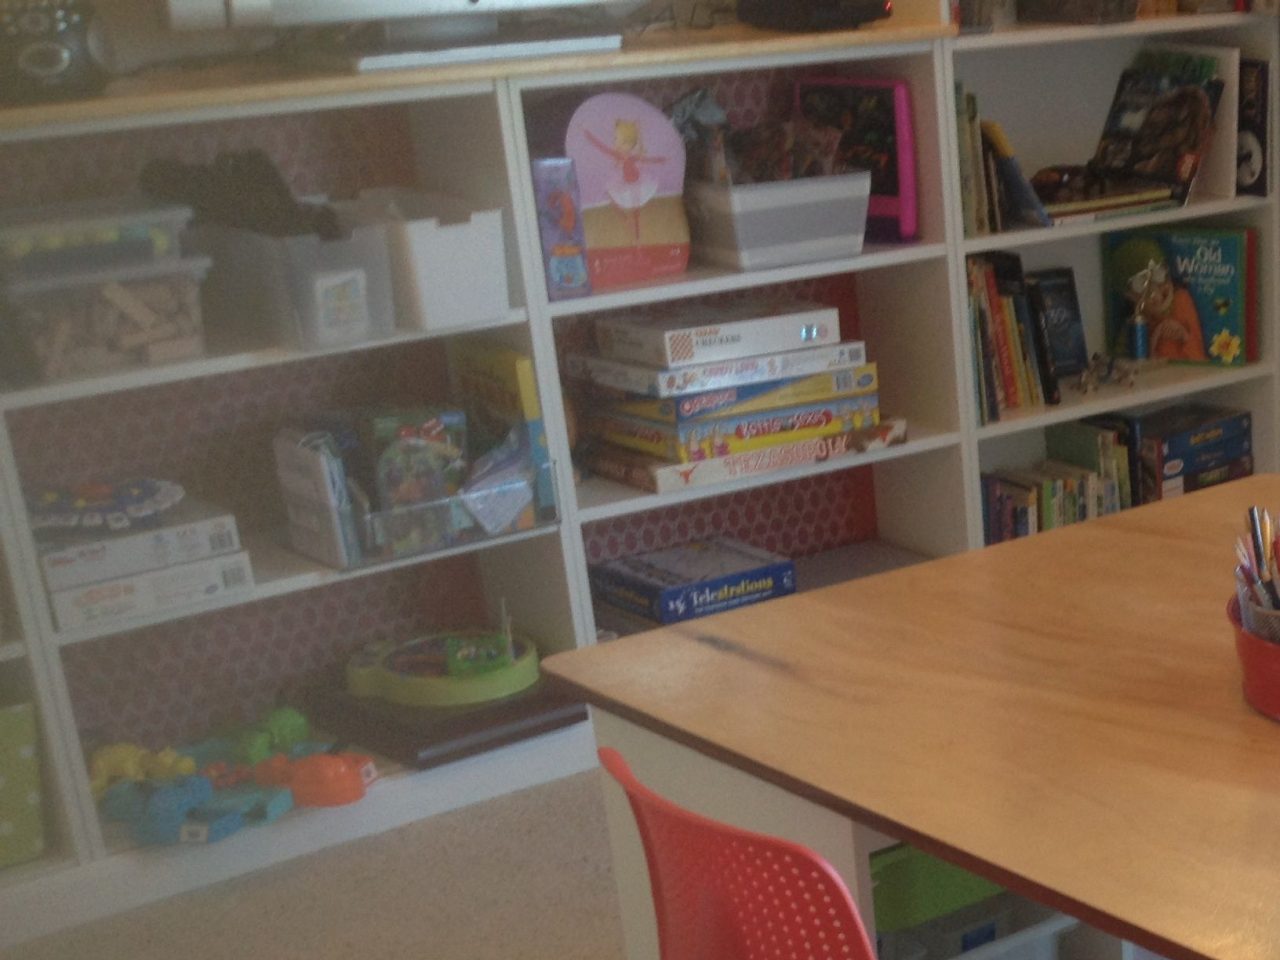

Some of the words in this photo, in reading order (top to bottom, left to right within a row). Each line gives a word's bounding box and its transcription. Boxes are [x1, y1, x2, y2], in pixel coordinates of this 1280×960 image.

[1196, 247, 1222, 263] Old
[1177, 256, 1235, 277] Woman
[693, 577, 774, 607] Telestrations
